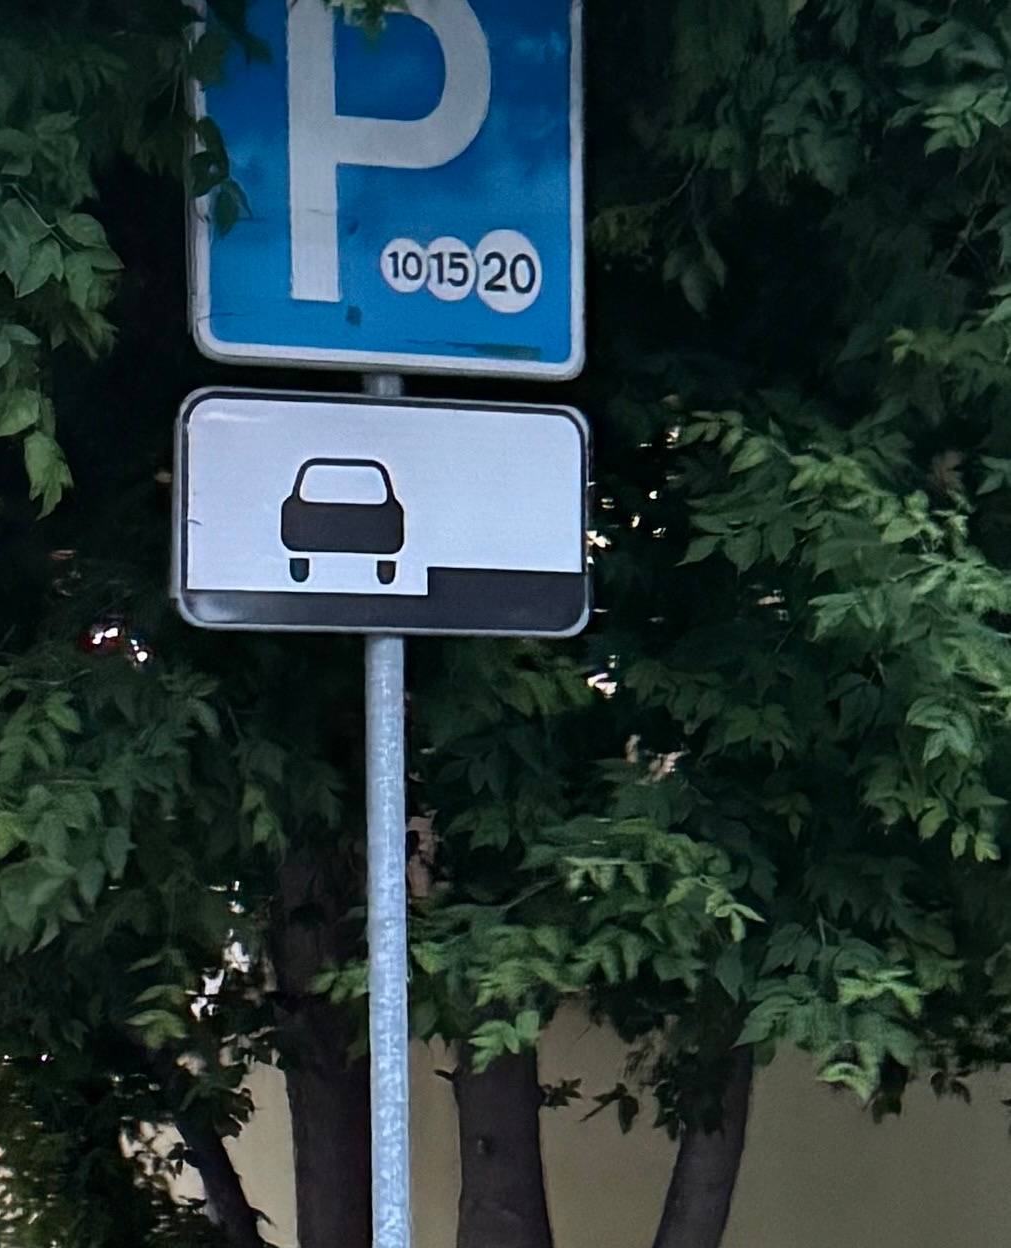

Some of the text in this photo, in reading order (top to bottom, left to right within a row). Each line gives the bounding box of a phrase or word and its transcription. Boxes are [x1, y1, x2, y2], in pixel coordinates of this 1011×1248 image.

[287, 0, 491, 302] P
[388, 251, 536, 294] 10 15 20
